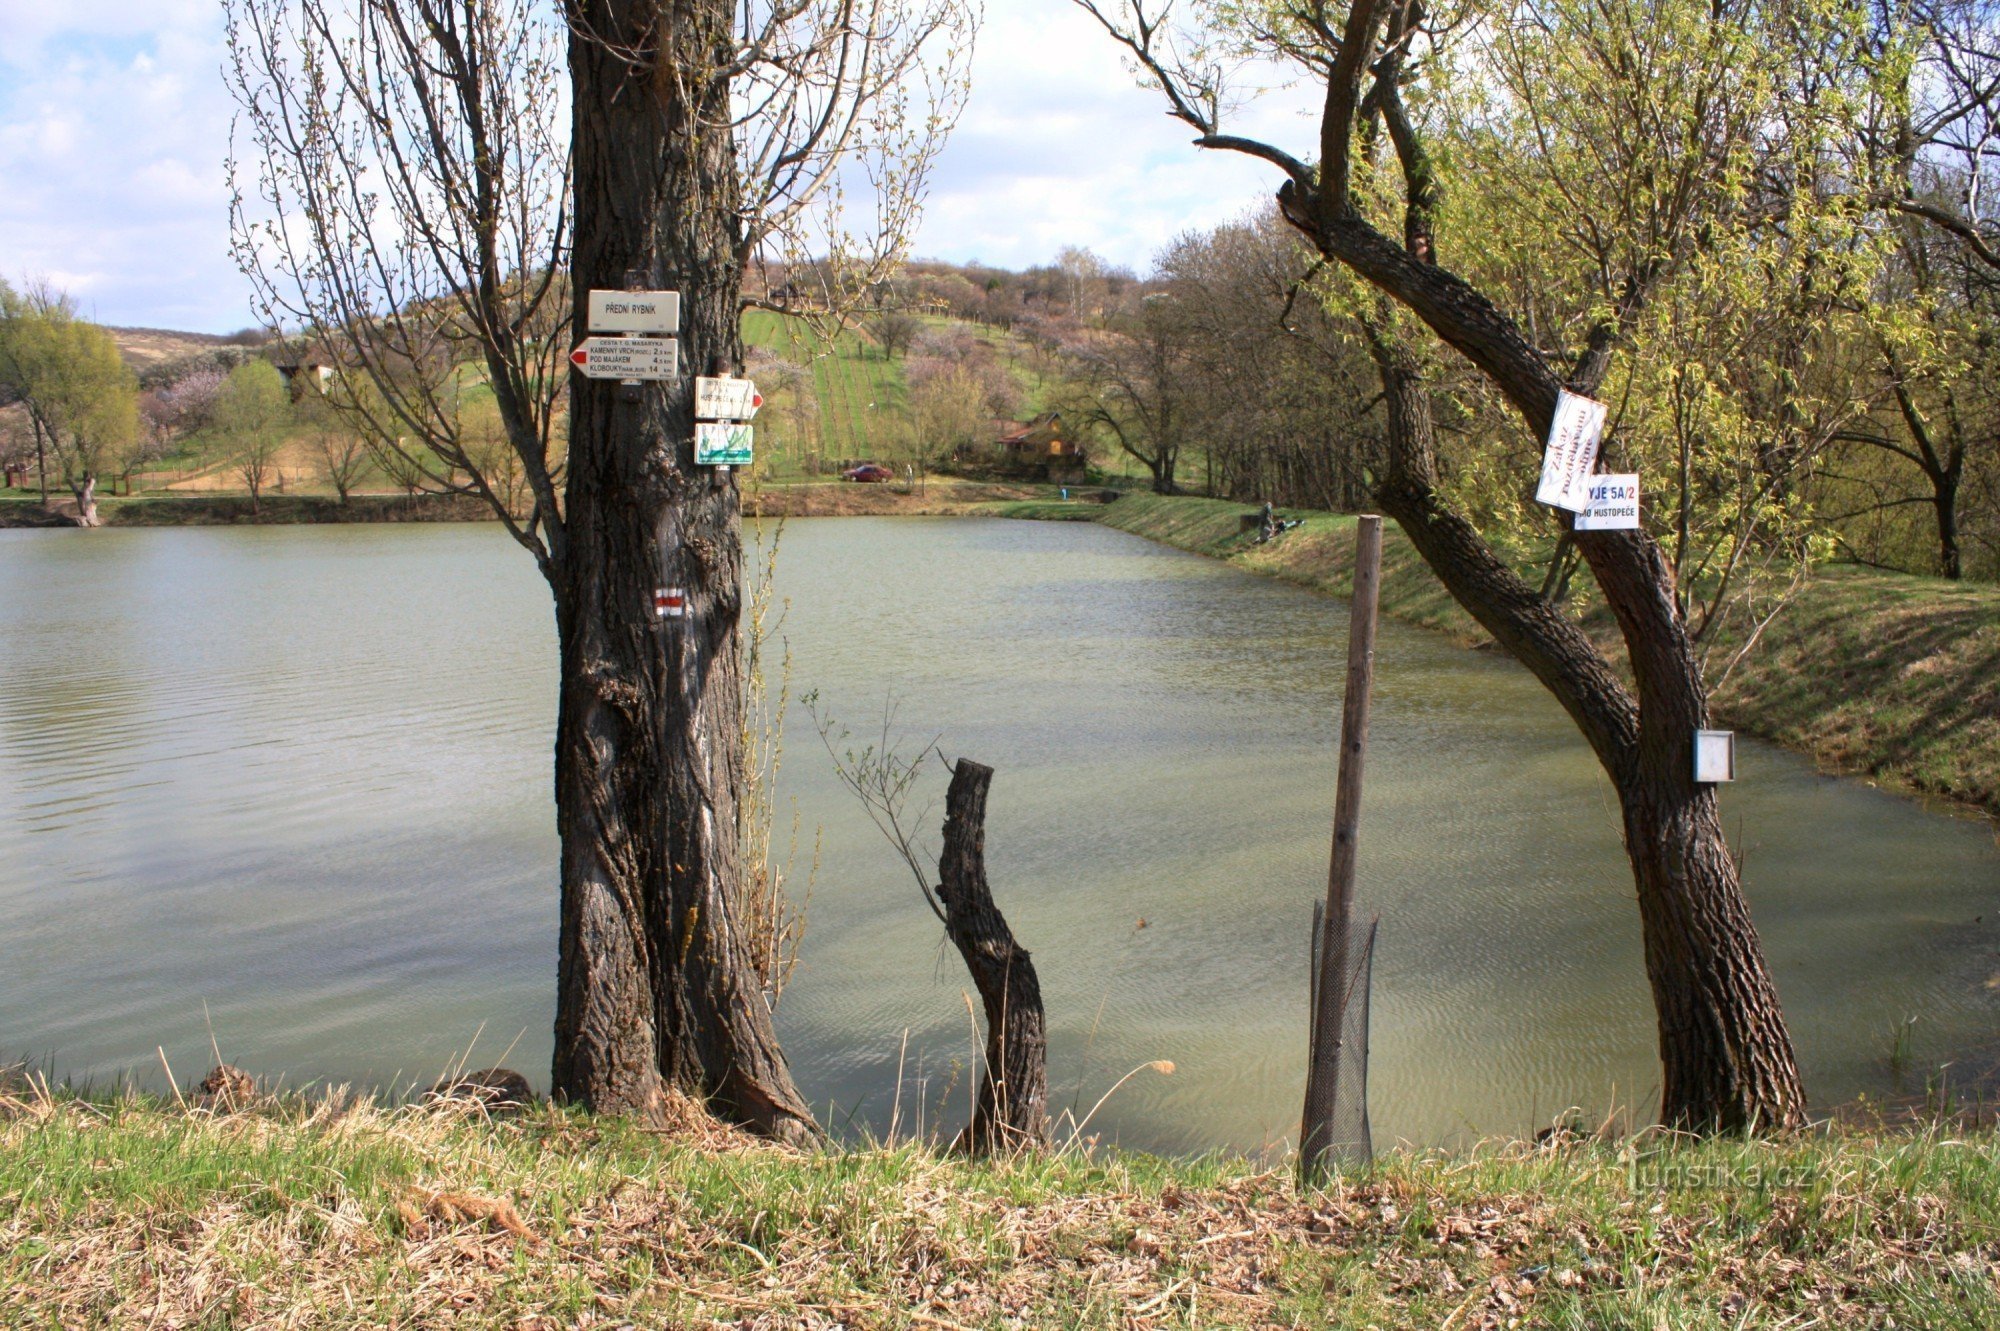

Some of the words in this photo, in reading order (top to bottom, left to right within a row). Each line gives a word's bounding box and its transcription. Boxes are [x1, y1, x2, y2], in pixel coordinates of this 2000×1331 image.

[605, 302, 630, 314] PŘEDNÍ
[632, 302, 656, 314] RYBNÍK
[619, 347, 635, 355] VRCH
[603, 355, 631, 363] MAJÁKEM
[590, 364, 622, 372] KLOBOUKY
[1552, 426, 1569, 471] Zákaz
[1588, 486, 1607, 500] YJE
[1611, 486, 1635, 500] 5A/2
[1594, 506, 1635, 517] HUSTOPEČE
